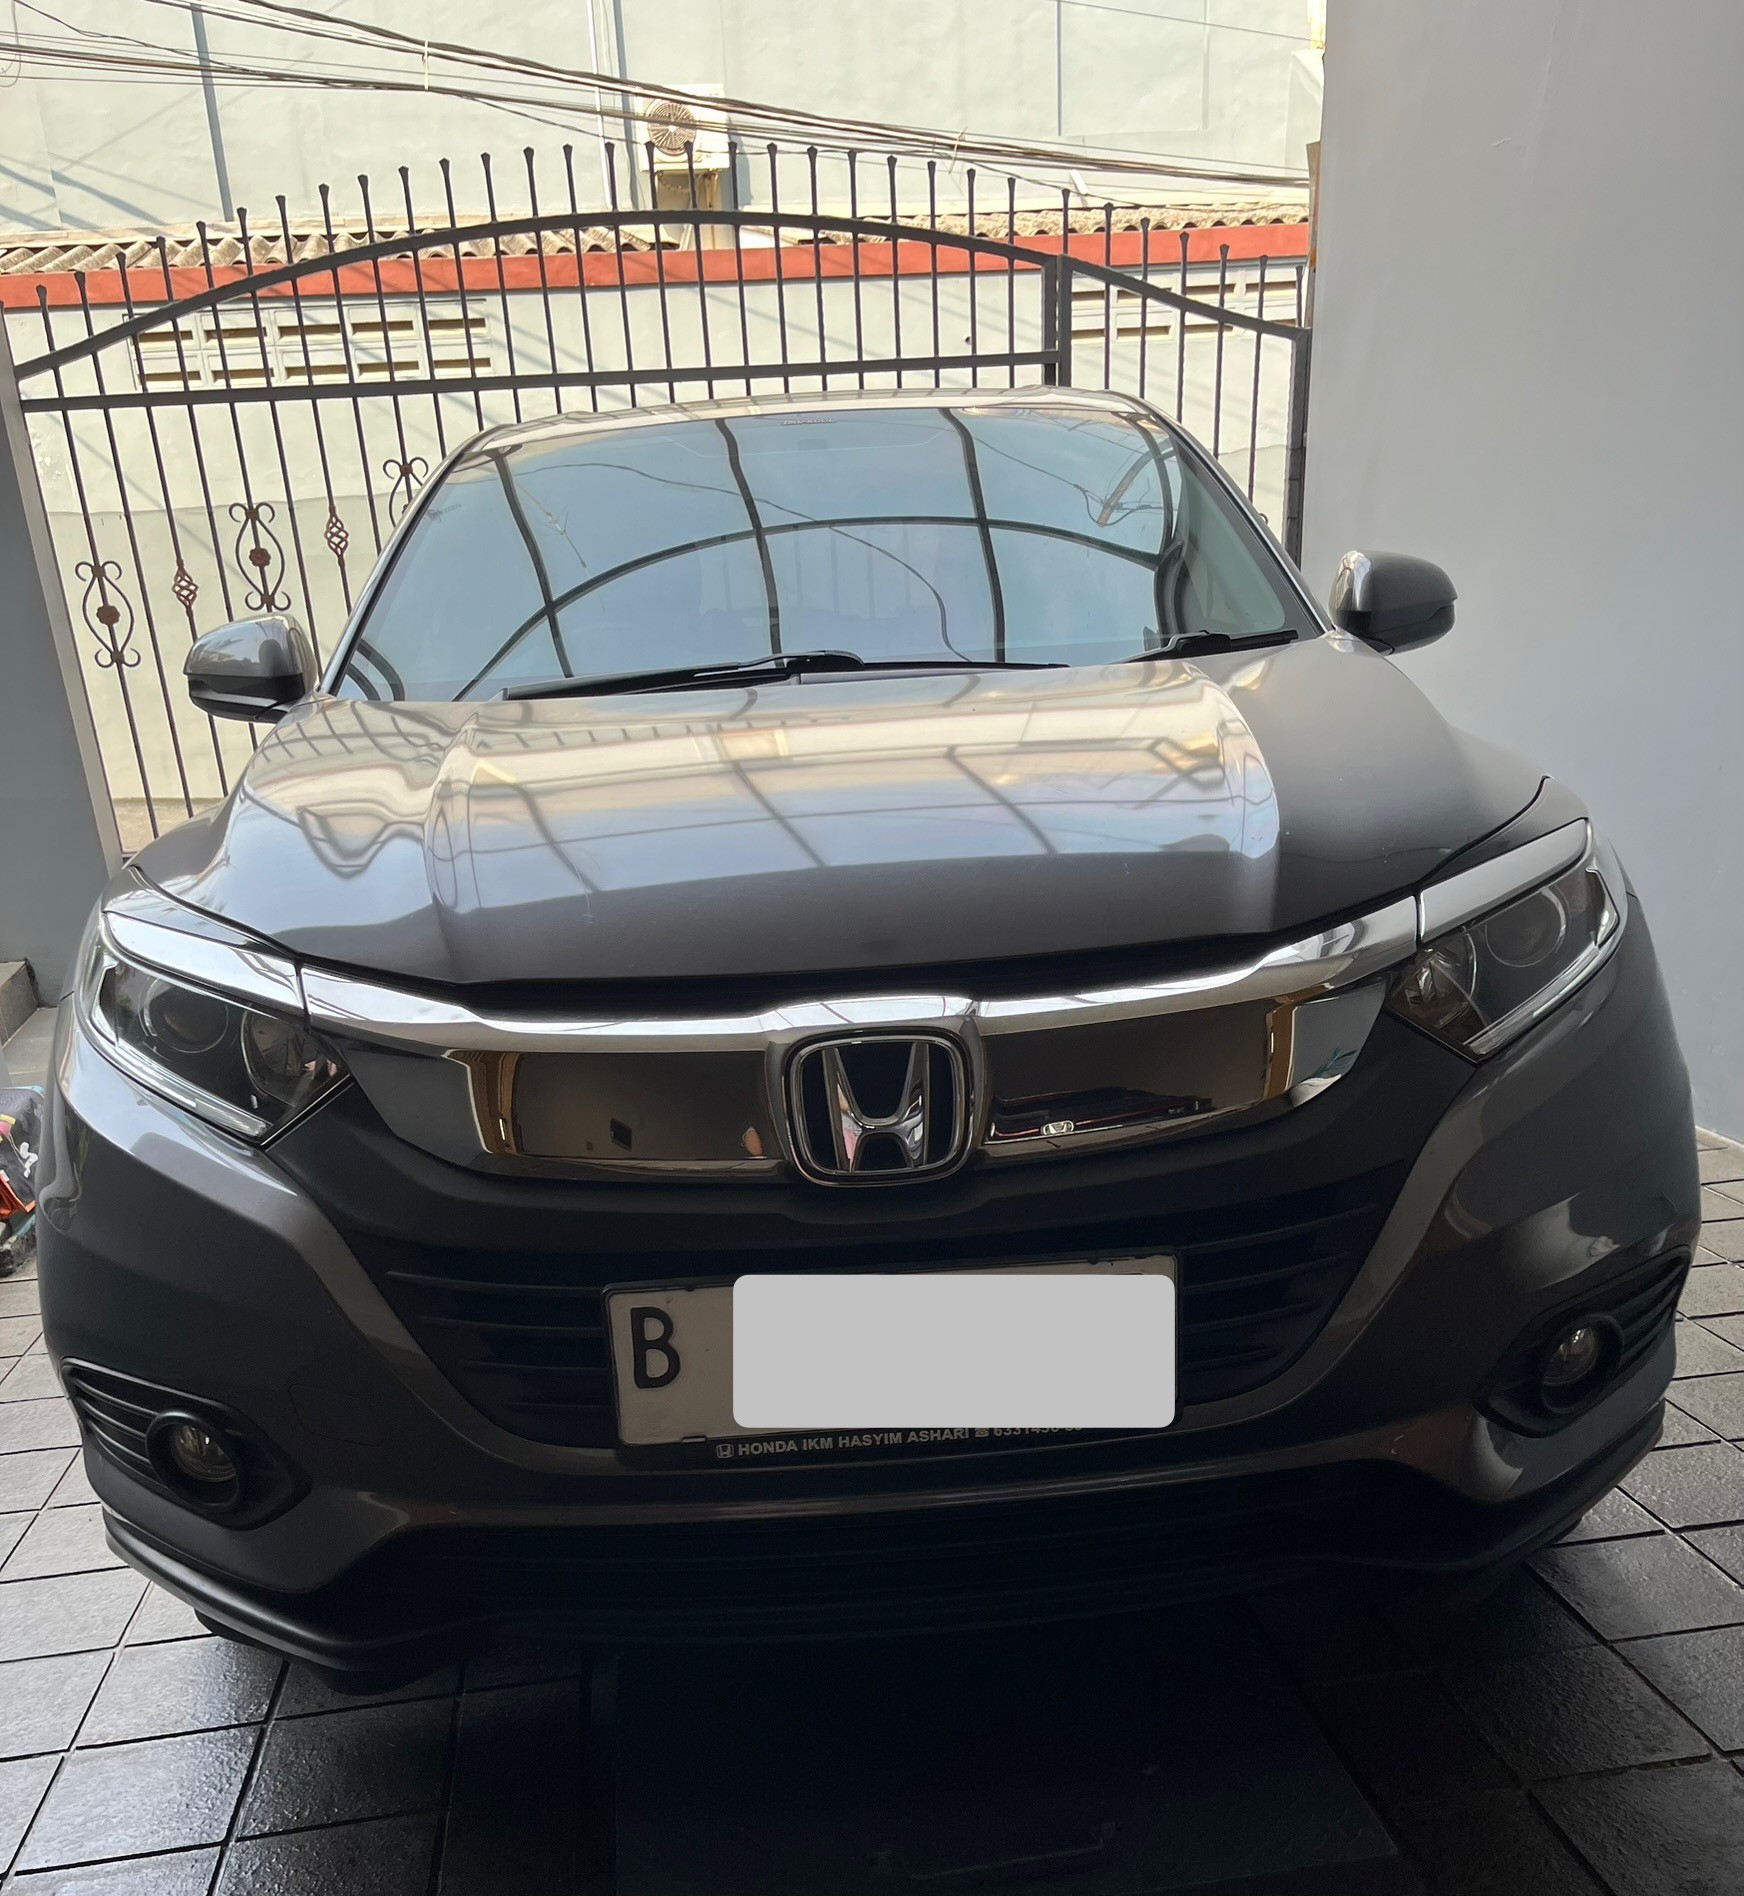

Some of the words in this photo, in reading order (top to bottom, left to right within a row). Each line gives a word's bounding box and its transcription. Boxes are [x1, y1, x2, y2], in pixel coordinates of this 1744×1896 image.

[630, 1306, 680, 1389] B
[738, 1439, 798, 1456] HONDA
[803, 1437, 833, 1451] IKM
[838, 1432, 902, 1448] HASYIM
[907, 1428, 969, 1443] ASHARI
